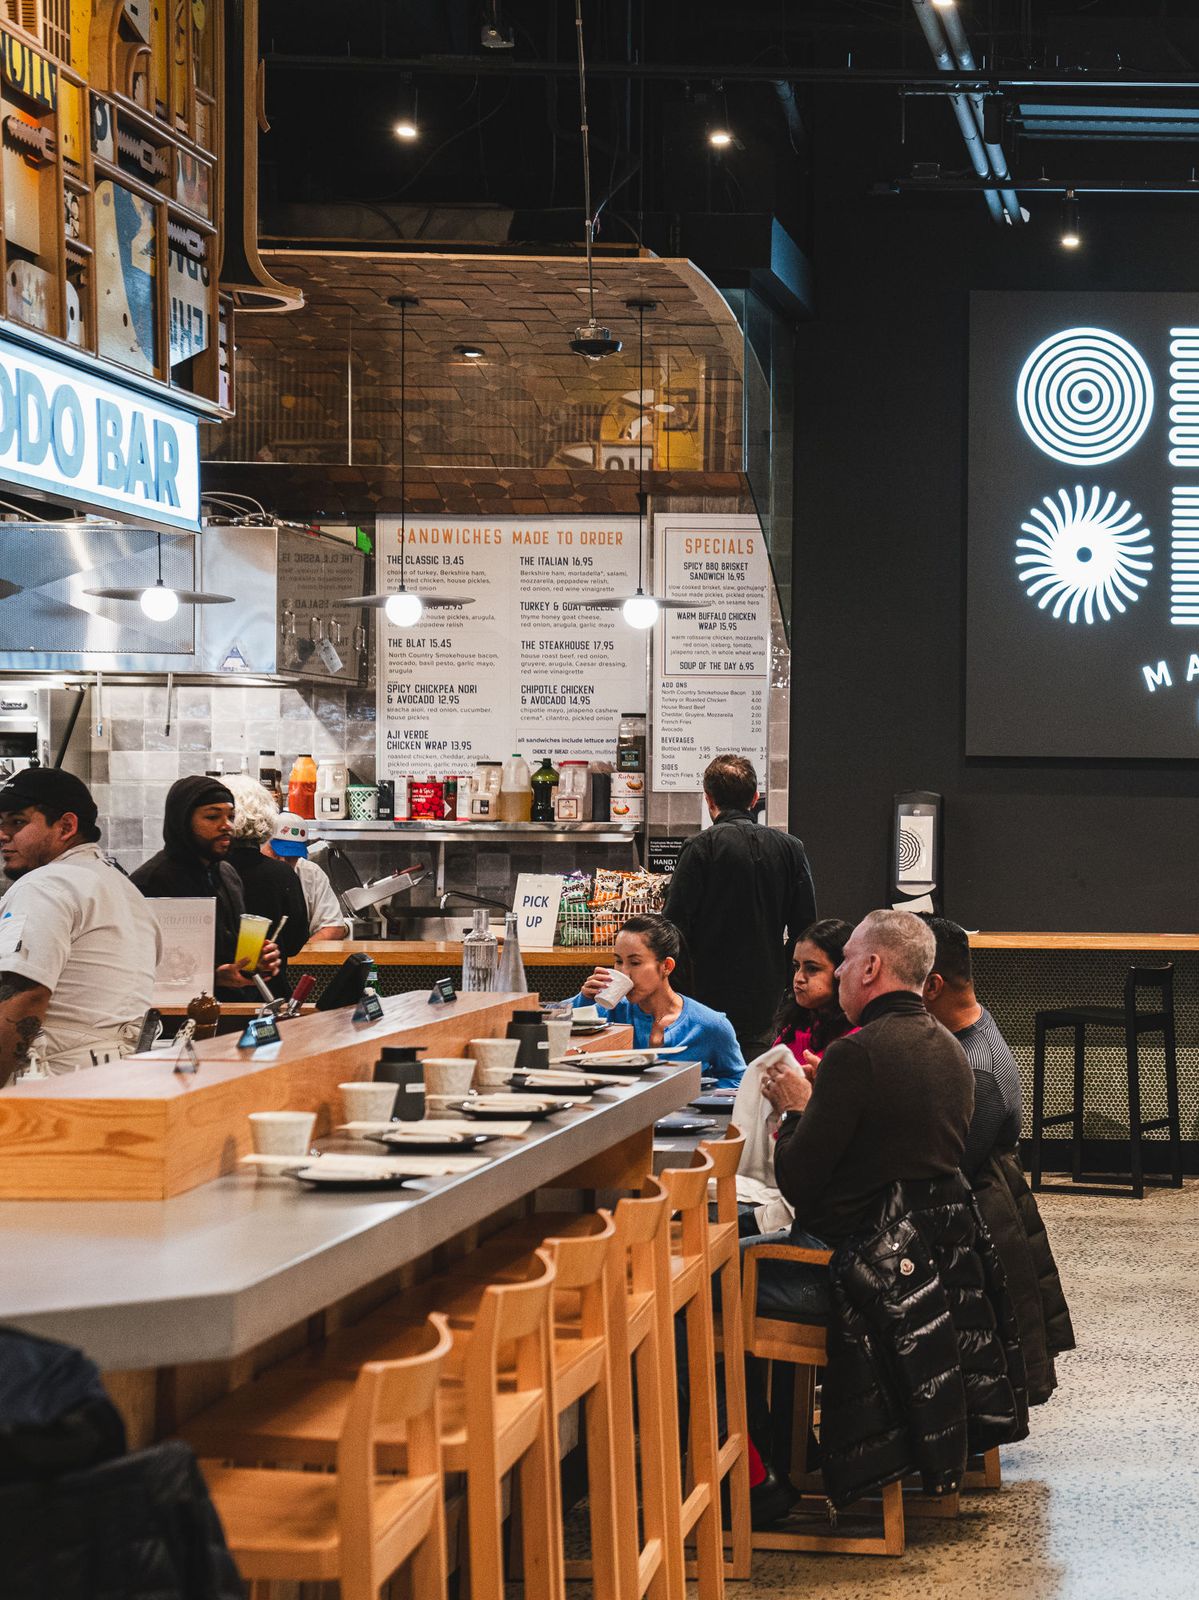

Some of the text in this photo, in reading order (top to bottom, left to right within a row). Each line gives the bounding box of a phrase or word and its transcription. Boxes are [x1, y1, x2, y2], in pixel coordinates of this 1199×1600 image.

[96, 398, 181, 508] BAR
[397, 528, 623, 545] SANDWICHES MADE TO ORDER
[685, 538, 754, 555] SPECIALS
[387, 555, 404, 565] THE
[405, 555, 439, 565] CLASSIC
[520, 556, 593, 566] THE ITALIAN 16.95
[683, 562, 748, 571] SPICY BBQ BRISKET
[689, 572, 745, 581] SANDWICH 16.95
[520, 601, 549, 611] TURKEY
[553, 601, 559, 611] &
[676, 611, 757, 621] WARM BUFFALO CHICKEN
[698, 622, 737, 631] WRAP 15.95
[388, 638, 452, 648] THE BLAT 15.45
[521, 640, 614, 650] THE STEAKHOUSE 17.95
[679, 661, 755, 671] SOUP OF THE DAY 6.95
[386, 684, 477, 694] SPICY CHICKPEA NORI
[520, 684, 594, 695] CHIPOTLE CHICKEN
[386, 695, 460, 705] & AVOCADO 12.95
[521, 695, 591, 706] & AVOCADO 14.95
[387, 730, 428, 740] AJI VERDE
[386, 741, 472, 751] CHICKEN WRAP 13.95
[522, 895, 549, 908] PICK
[525, 915, 542, 928] UP
